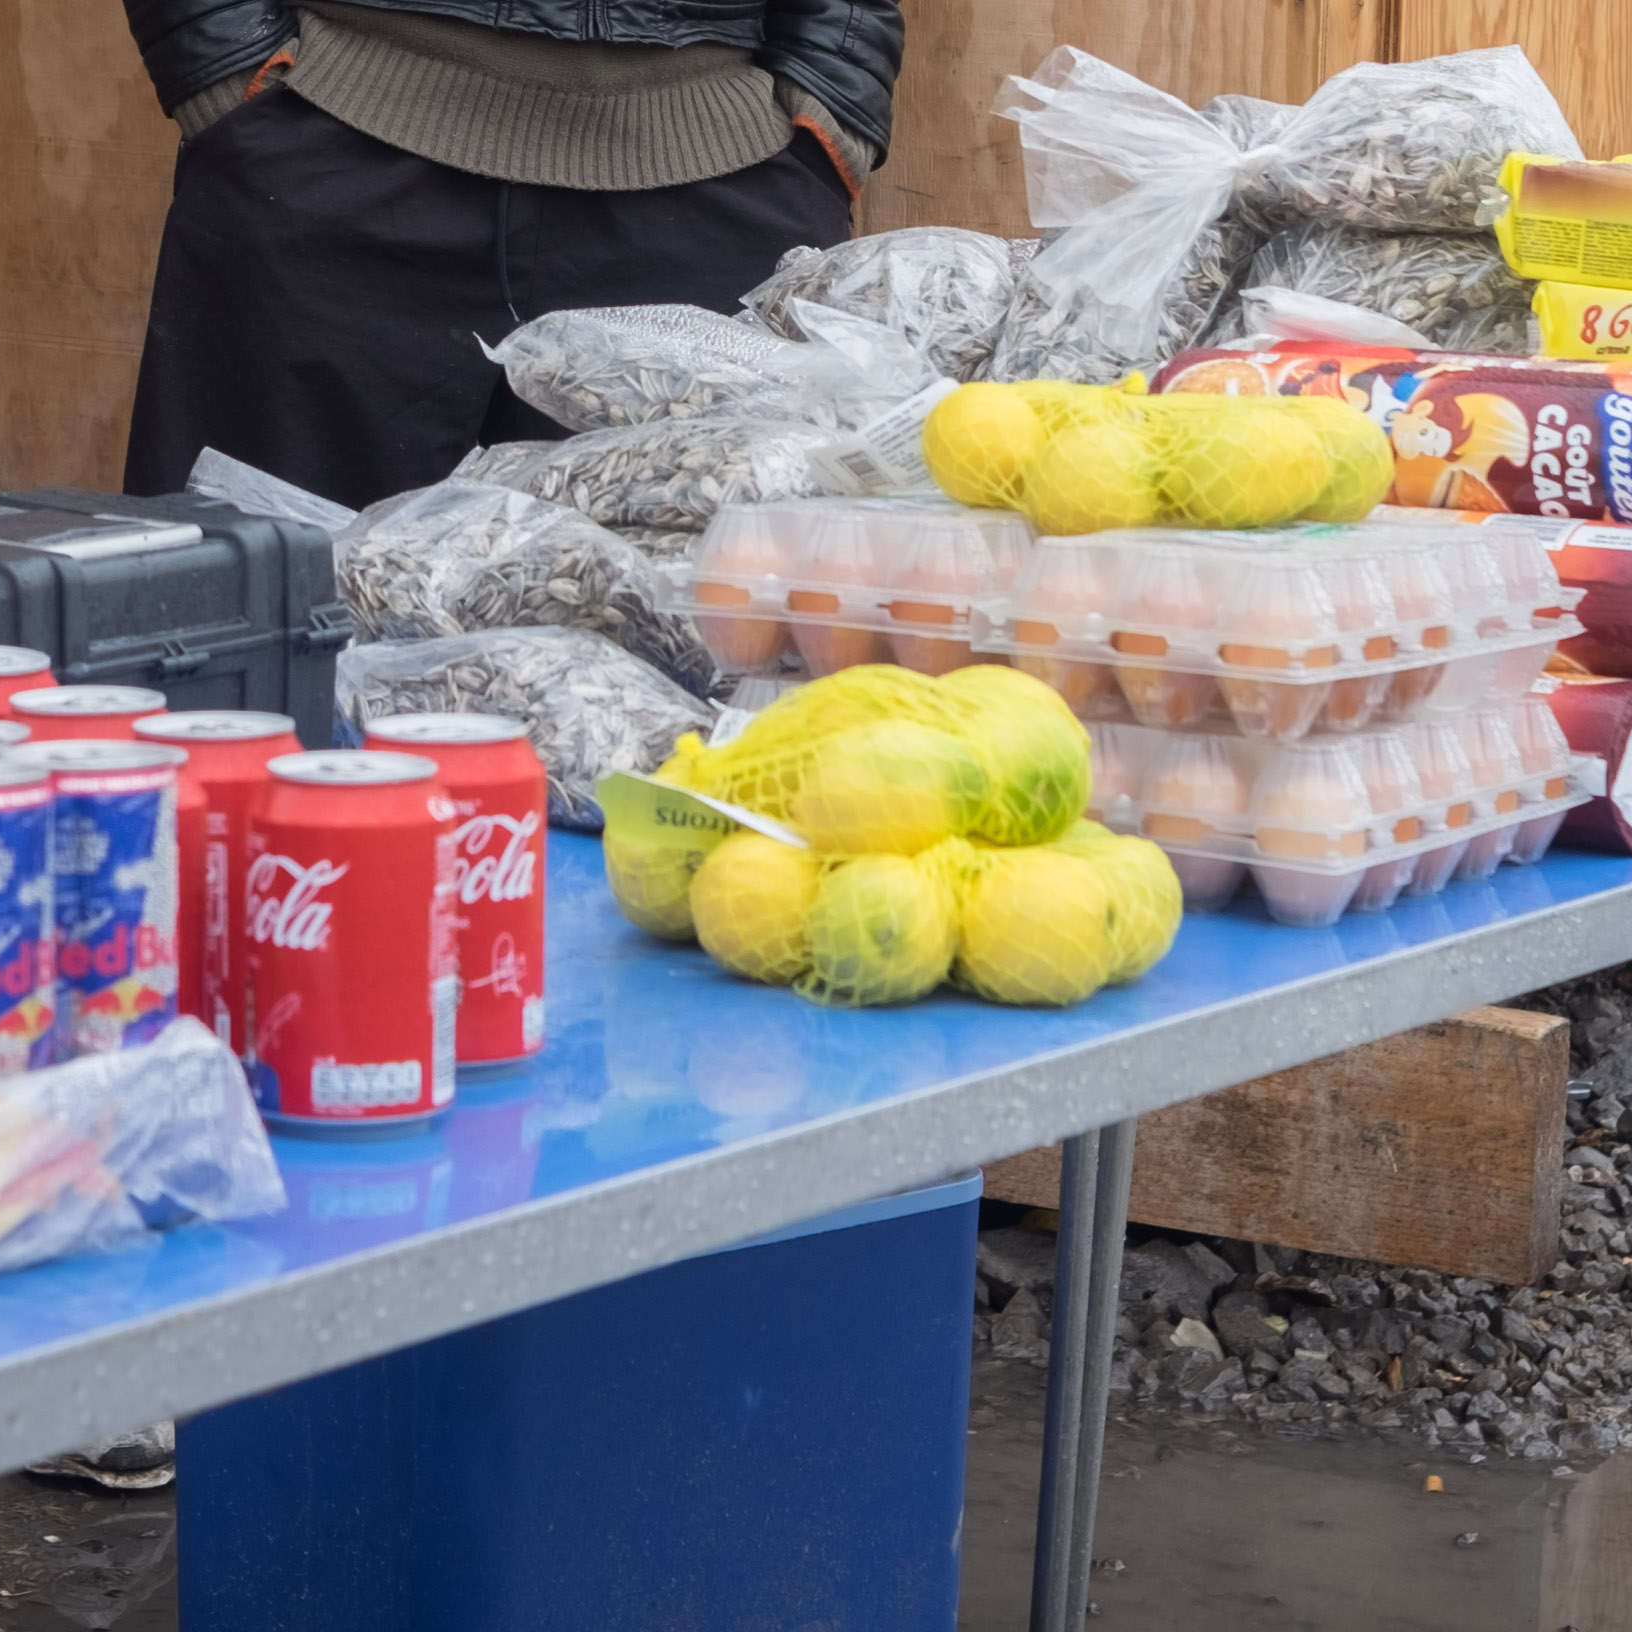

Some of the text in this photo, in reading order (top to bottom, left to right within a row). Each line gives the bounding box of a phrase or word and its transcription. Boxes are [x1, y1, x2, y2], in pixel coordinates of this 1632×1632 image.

[1580, 304, 1602, 344] 8
[1531, 404, 1570, 517] CACAO
[54, 924, 127, 980] ed
